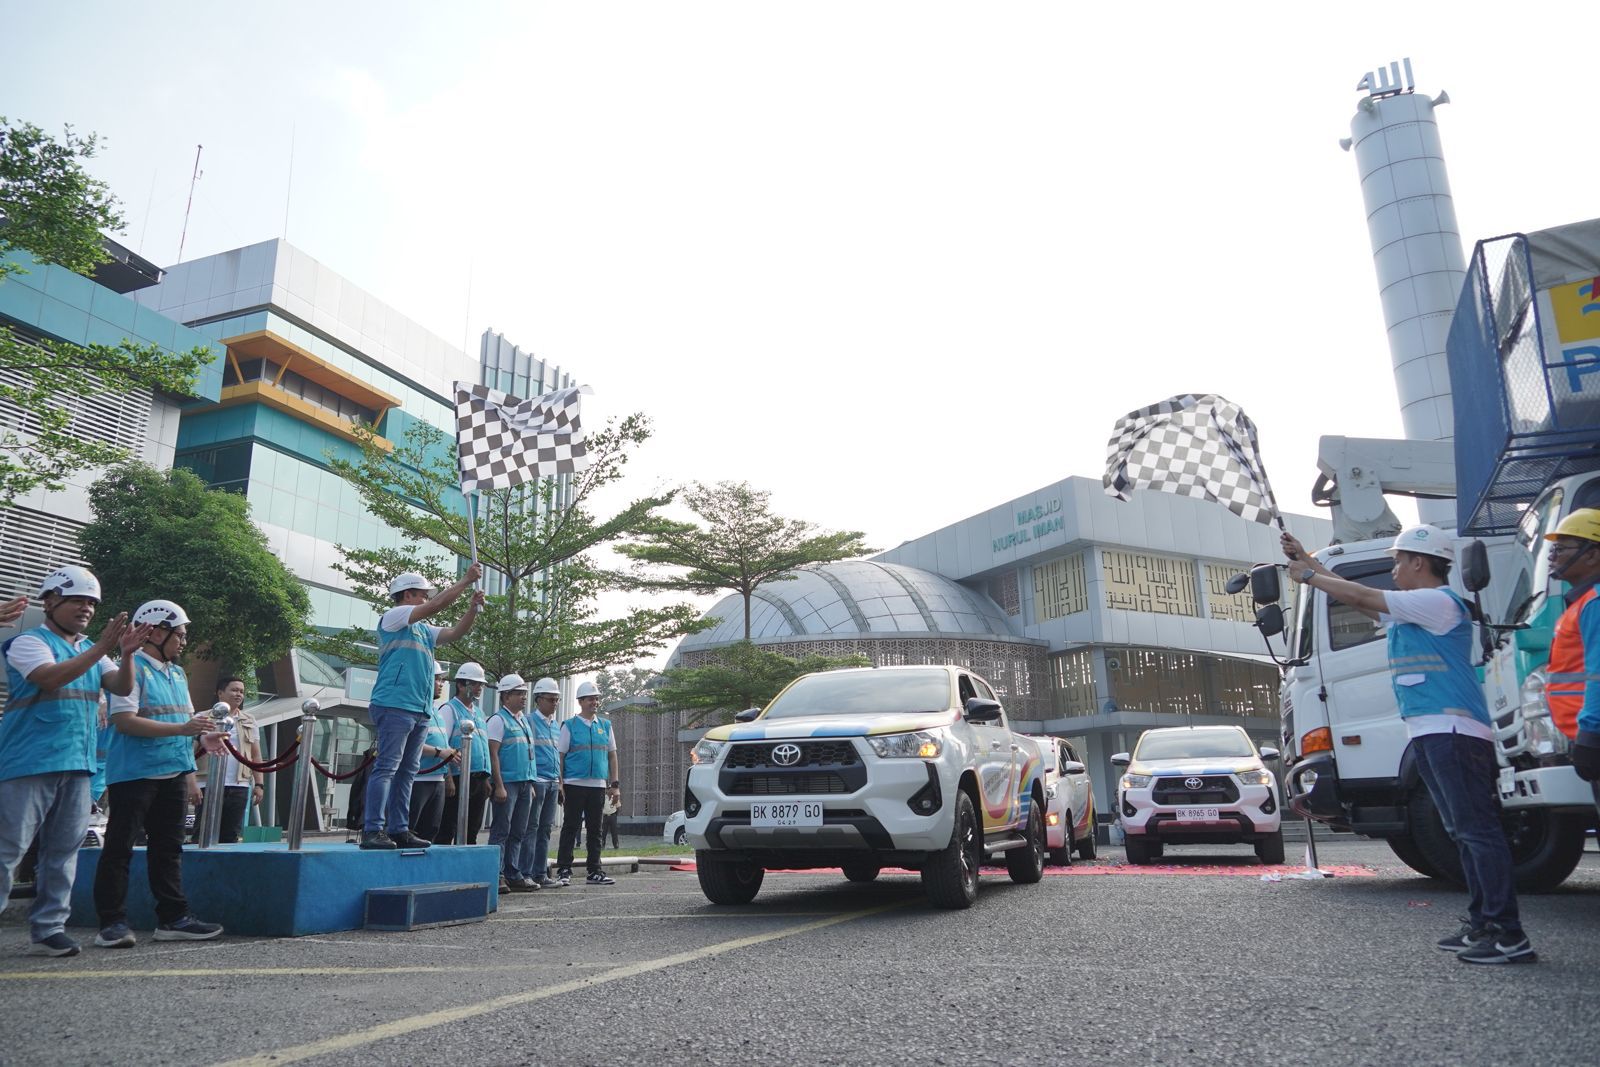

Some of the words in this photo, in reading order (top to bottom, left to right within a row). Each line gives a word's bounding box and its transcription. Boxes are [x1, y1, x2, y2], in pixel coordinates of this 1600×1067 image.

[1016, 498, 1062, 526] MASJID
[992, 529, 1031, 552] NURUL
[1033, 516, 1064, 539] IMAN
[753, 806, 767, 819] BK
[772, 804, 799, 818] 8879
[804, 804, 820, 818] GO
